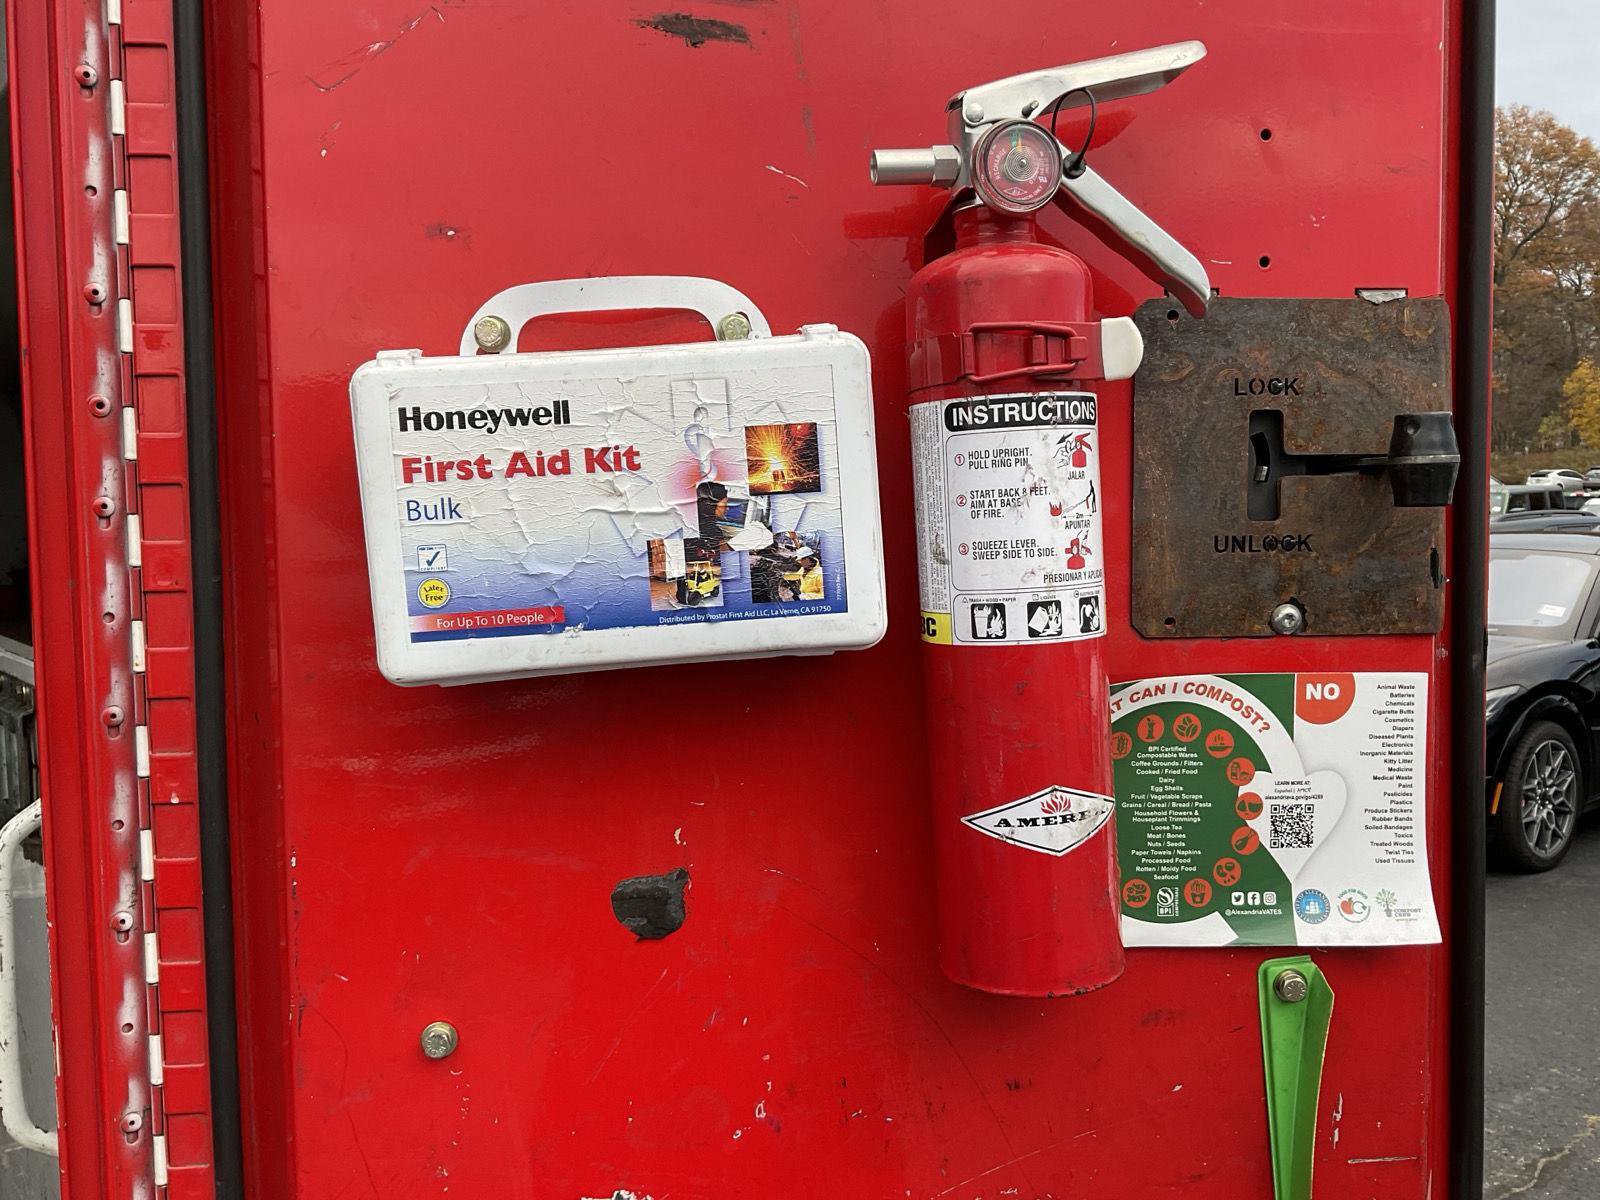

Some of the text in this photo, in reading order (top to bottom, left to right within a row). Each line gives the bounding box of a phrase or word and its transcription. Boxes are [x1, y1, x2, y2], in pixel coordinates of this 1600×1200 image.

[1234, 377, 1300, 396] LOCK
[398, 400, 571, 434] Honeywell
[952, 400, 1096, 427] INSTRUCTIONS
[968, 449, 990, 460] HOLD
[992, 447, 1033, 459] UPRIGHT.
[401, 445, 642, 484] First Aid Kit
[968, 460, 989, 469] PULL
[991, 459, 1012, 469] RING
[1067, 471, 1085, 480] JALAR
[970, 489, 995, 499] START
[997, 488, 1020, 498] BACK
[1029, 486, 1051, 496] FEET.
[406, 497, 463, 522] Bulk
[970, 497, 1022, 509] AIM AT BASE
[970, 508, 1005, 519] OF FIRE.
[1064, 519, 1091, 530] APUNTAR
[972, 539, 1008, 550] SQUEEZE
[1010, 539, 1039, 549] LEVER.
[1213, 534, 1313, 553] UNLOCK
[972, 547, 1058, 561] SWEEP SIDE TO SIDE.
[1043, 571, 1082, 583] PRESIONAR
[1083, 571, 1087, 580] Y
[423, 584, 444, 593] Latex
[425, 593, 444, 602] Free
[436, 611, 544, 629] For Up To 10 People
[659, 605, 832, 624] Distributed by Prostat First Aid LLC, La Verne, CA 91750
[1305, 683, 1341, 700] NO
[1129, 684, 1166, 704] CAN
[1171, 682, 1178, 694] I
[1183, 681, 1271, 734] COMPOST?
[994, 806, 1109, 828] AMERE
[1159, 907, 1172, 915] BPI
